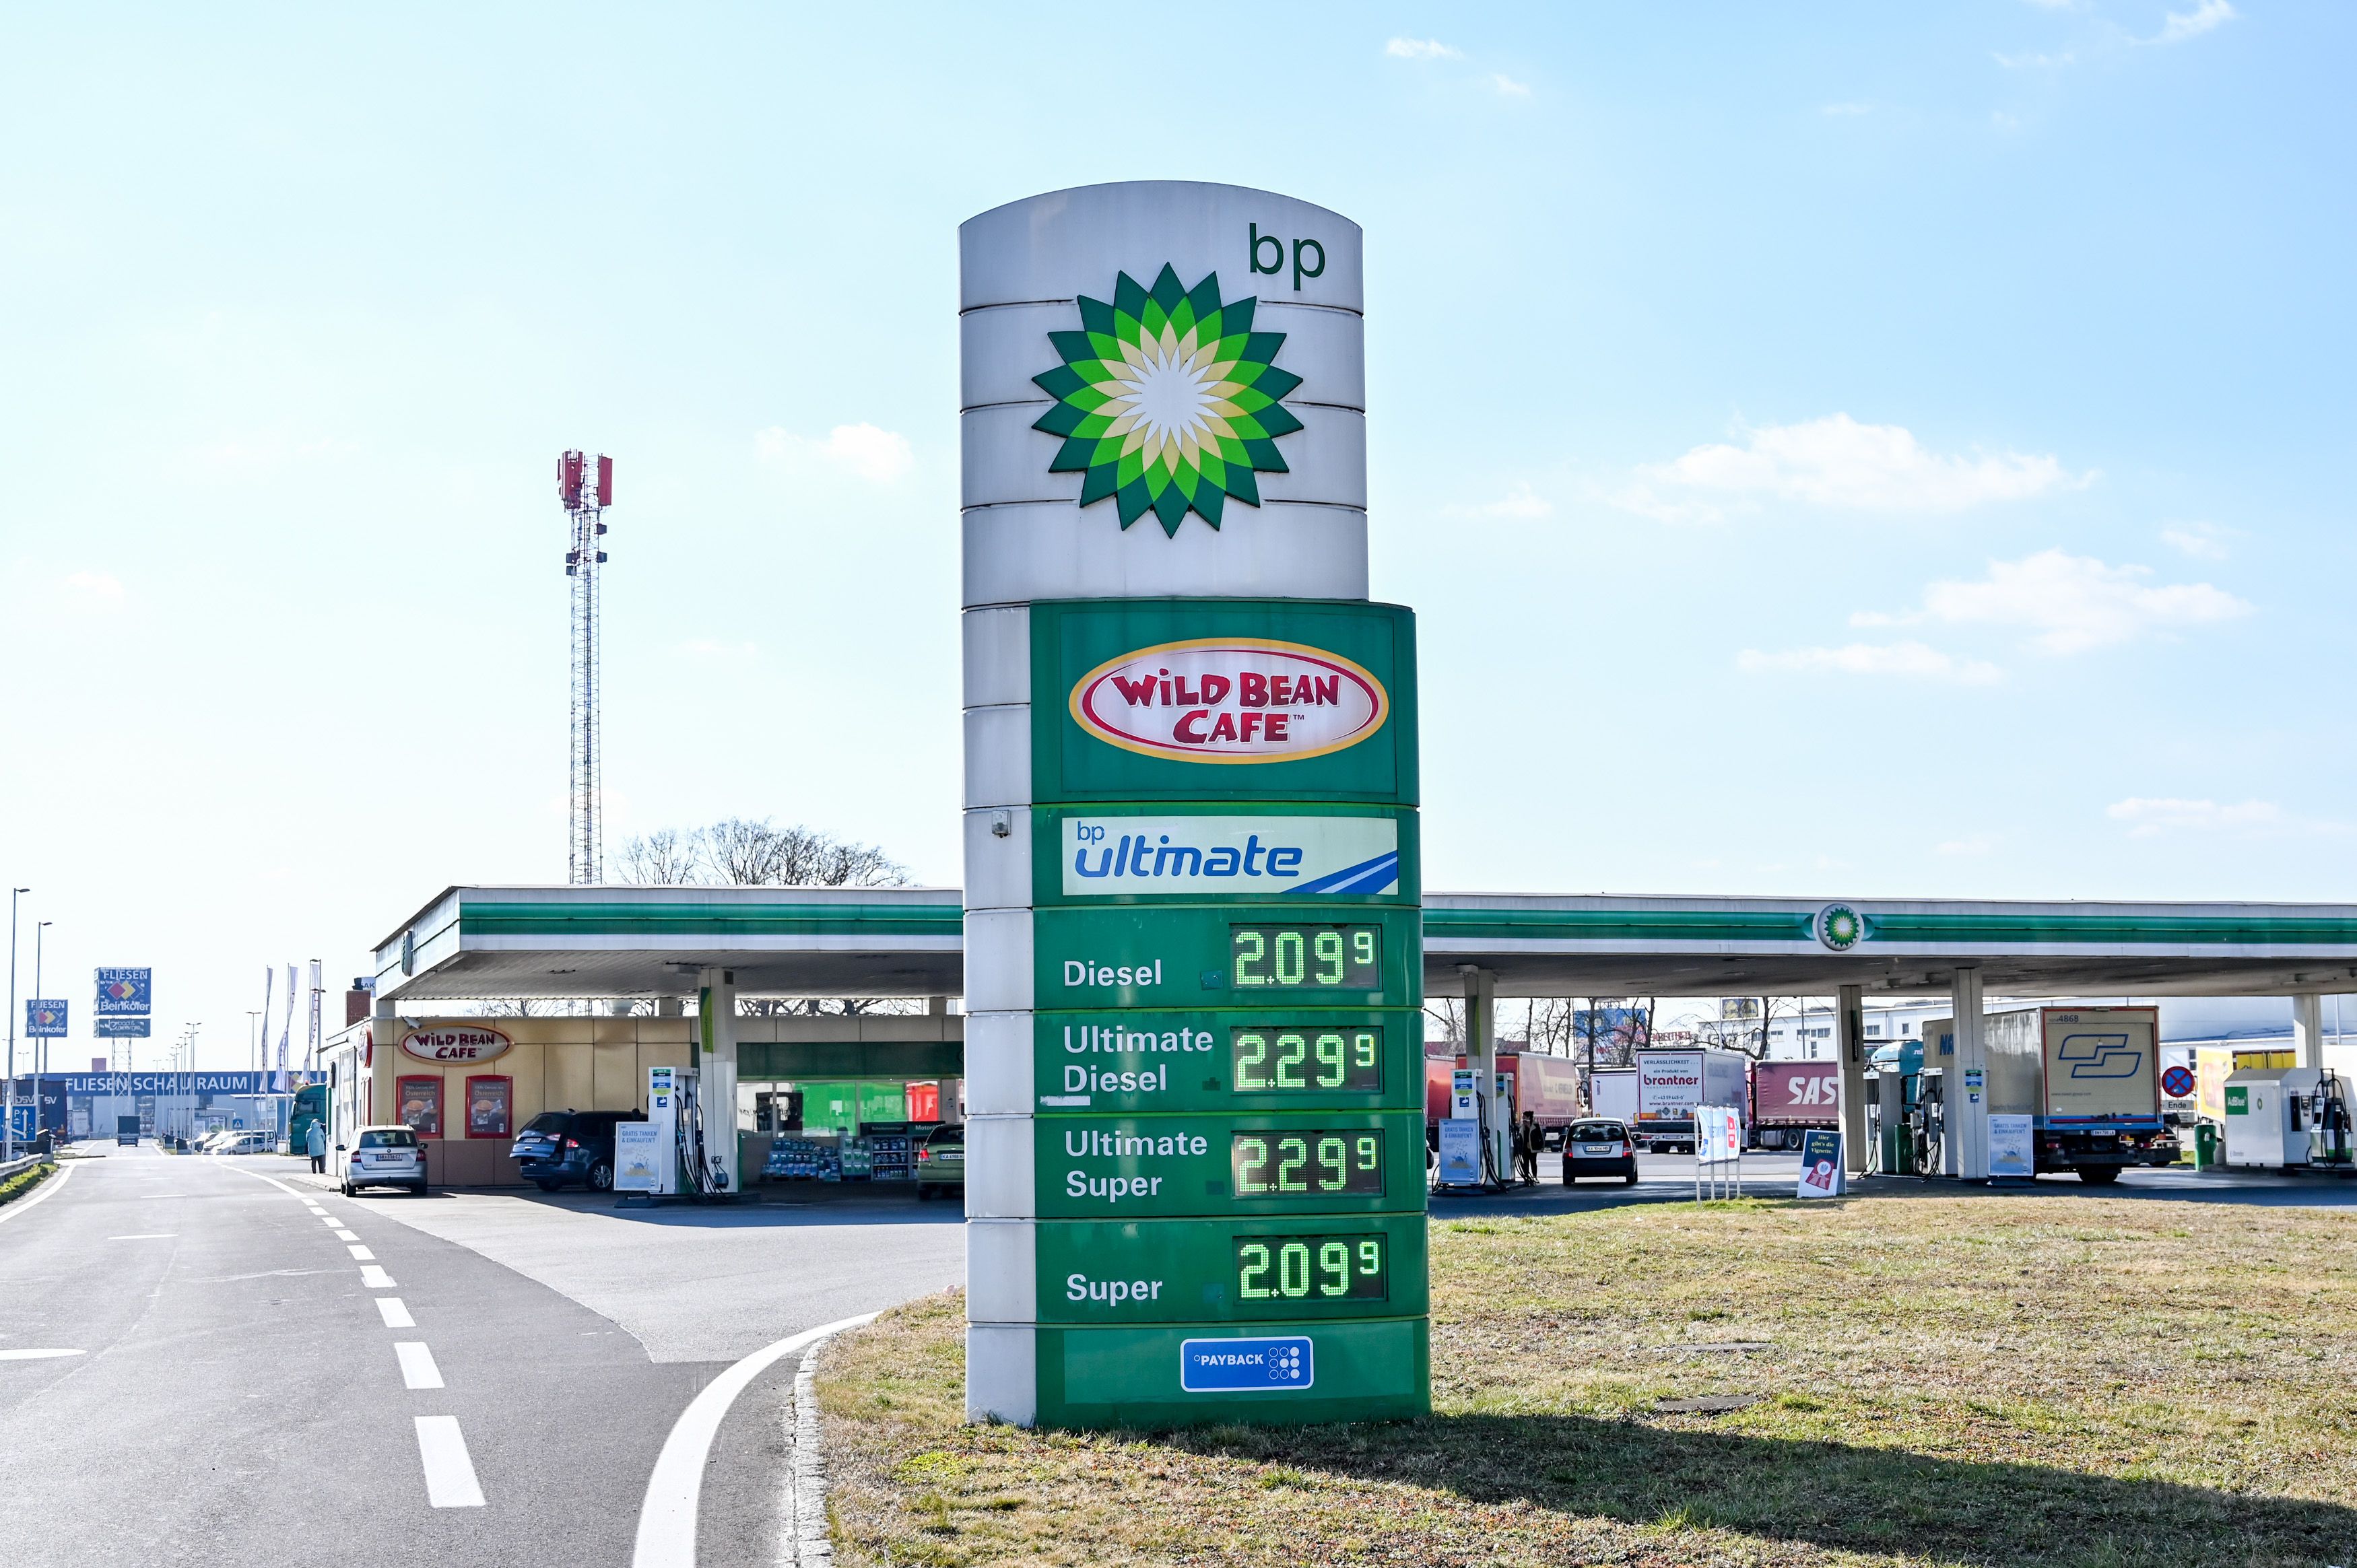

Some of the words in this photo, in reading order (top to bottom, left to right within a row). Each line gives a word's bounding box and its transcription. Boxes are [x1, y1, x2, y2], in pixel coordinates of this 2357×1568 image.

[1249, 223, 1325, 291] bp
[1239, 672, 1340, 708] BEAN
[1077, 821, 1105, 845] bp
[1075, 835, 1302, 877] ultimate
[103, 970, 147, 979] FLIESEN
[1064, 959, 1162, 986] Diesel
[100, 1001, 150, 1011] Beinkofer
[459, 1033, 495, 1046] BEAN
[1064, 1026, 1214, 1053] Ultimate
[1064, 1064, 1166, 1092] Diesel
[1644, 1075, 1698, 1085] brantner
[14, 1110, 20, 1118] P
[1065, 1130, 1207, 1157] Ultimate
[1066, 1171, 1162, 1202] Super
[1066, 1274, 1163, 1306] Super
[1201, 1354, 1264, 1366] PAYBACK
